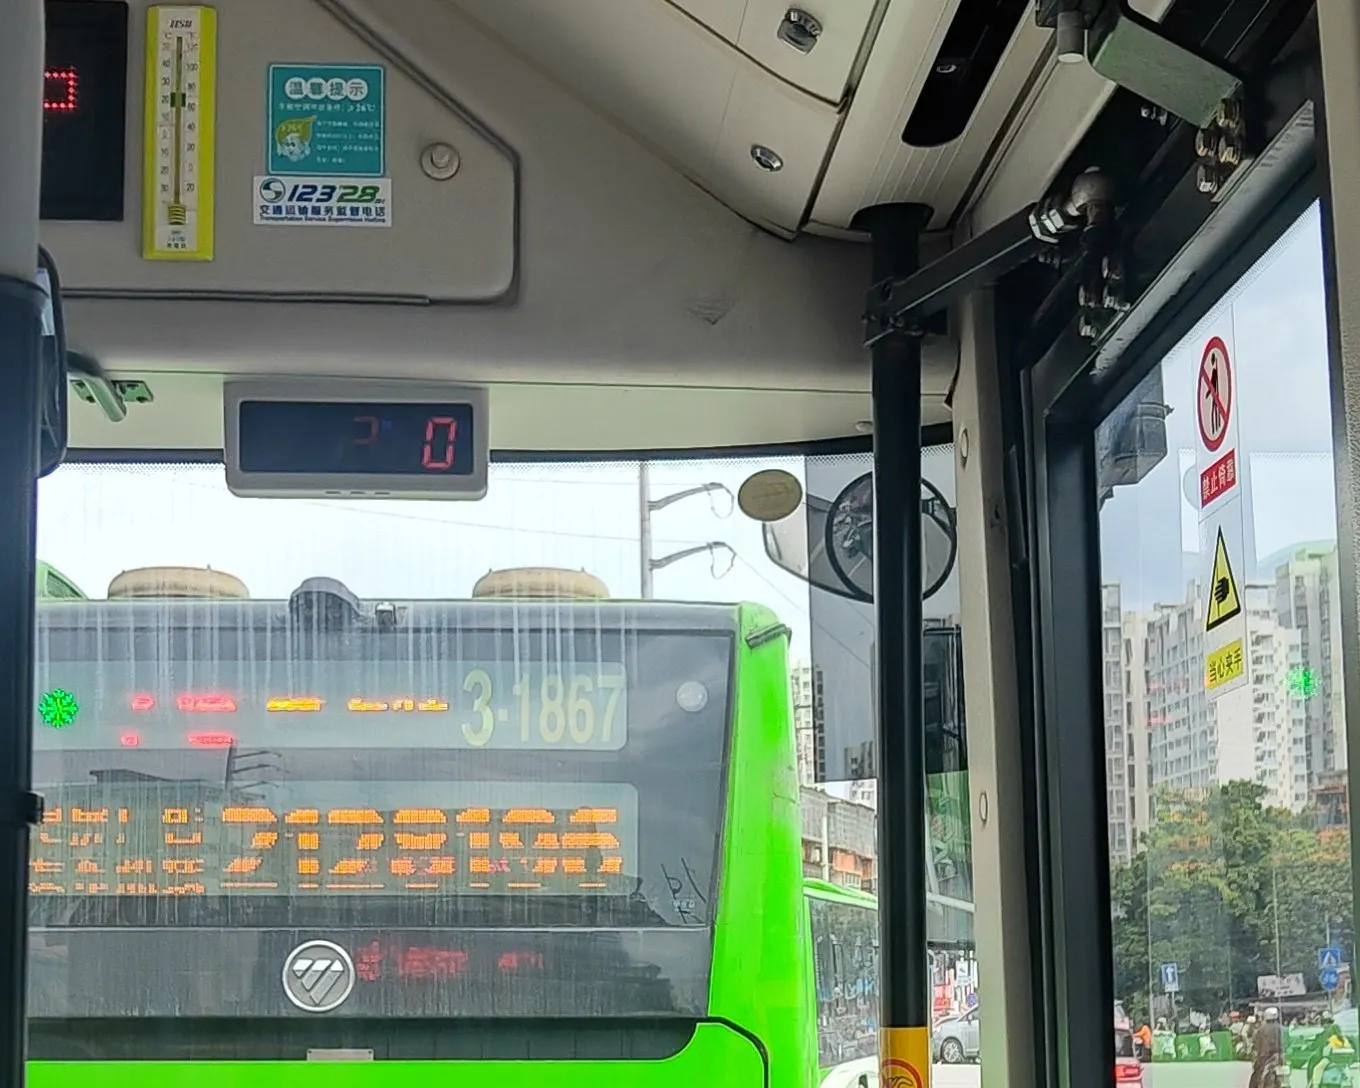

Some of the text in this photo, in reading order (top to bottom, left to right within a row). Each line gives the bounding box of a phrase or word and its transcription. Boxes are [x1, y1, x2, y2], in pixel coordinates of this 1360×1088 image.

[288, 80, 365, 97] 温馨提示
[288, 184, 380, 203] 12328
[260, 204, 386, 217] 交通运输服务监督电话
[1209, 647, 1242, 682] 当心夹手
[460, 669, 625, 747] 3-1867
